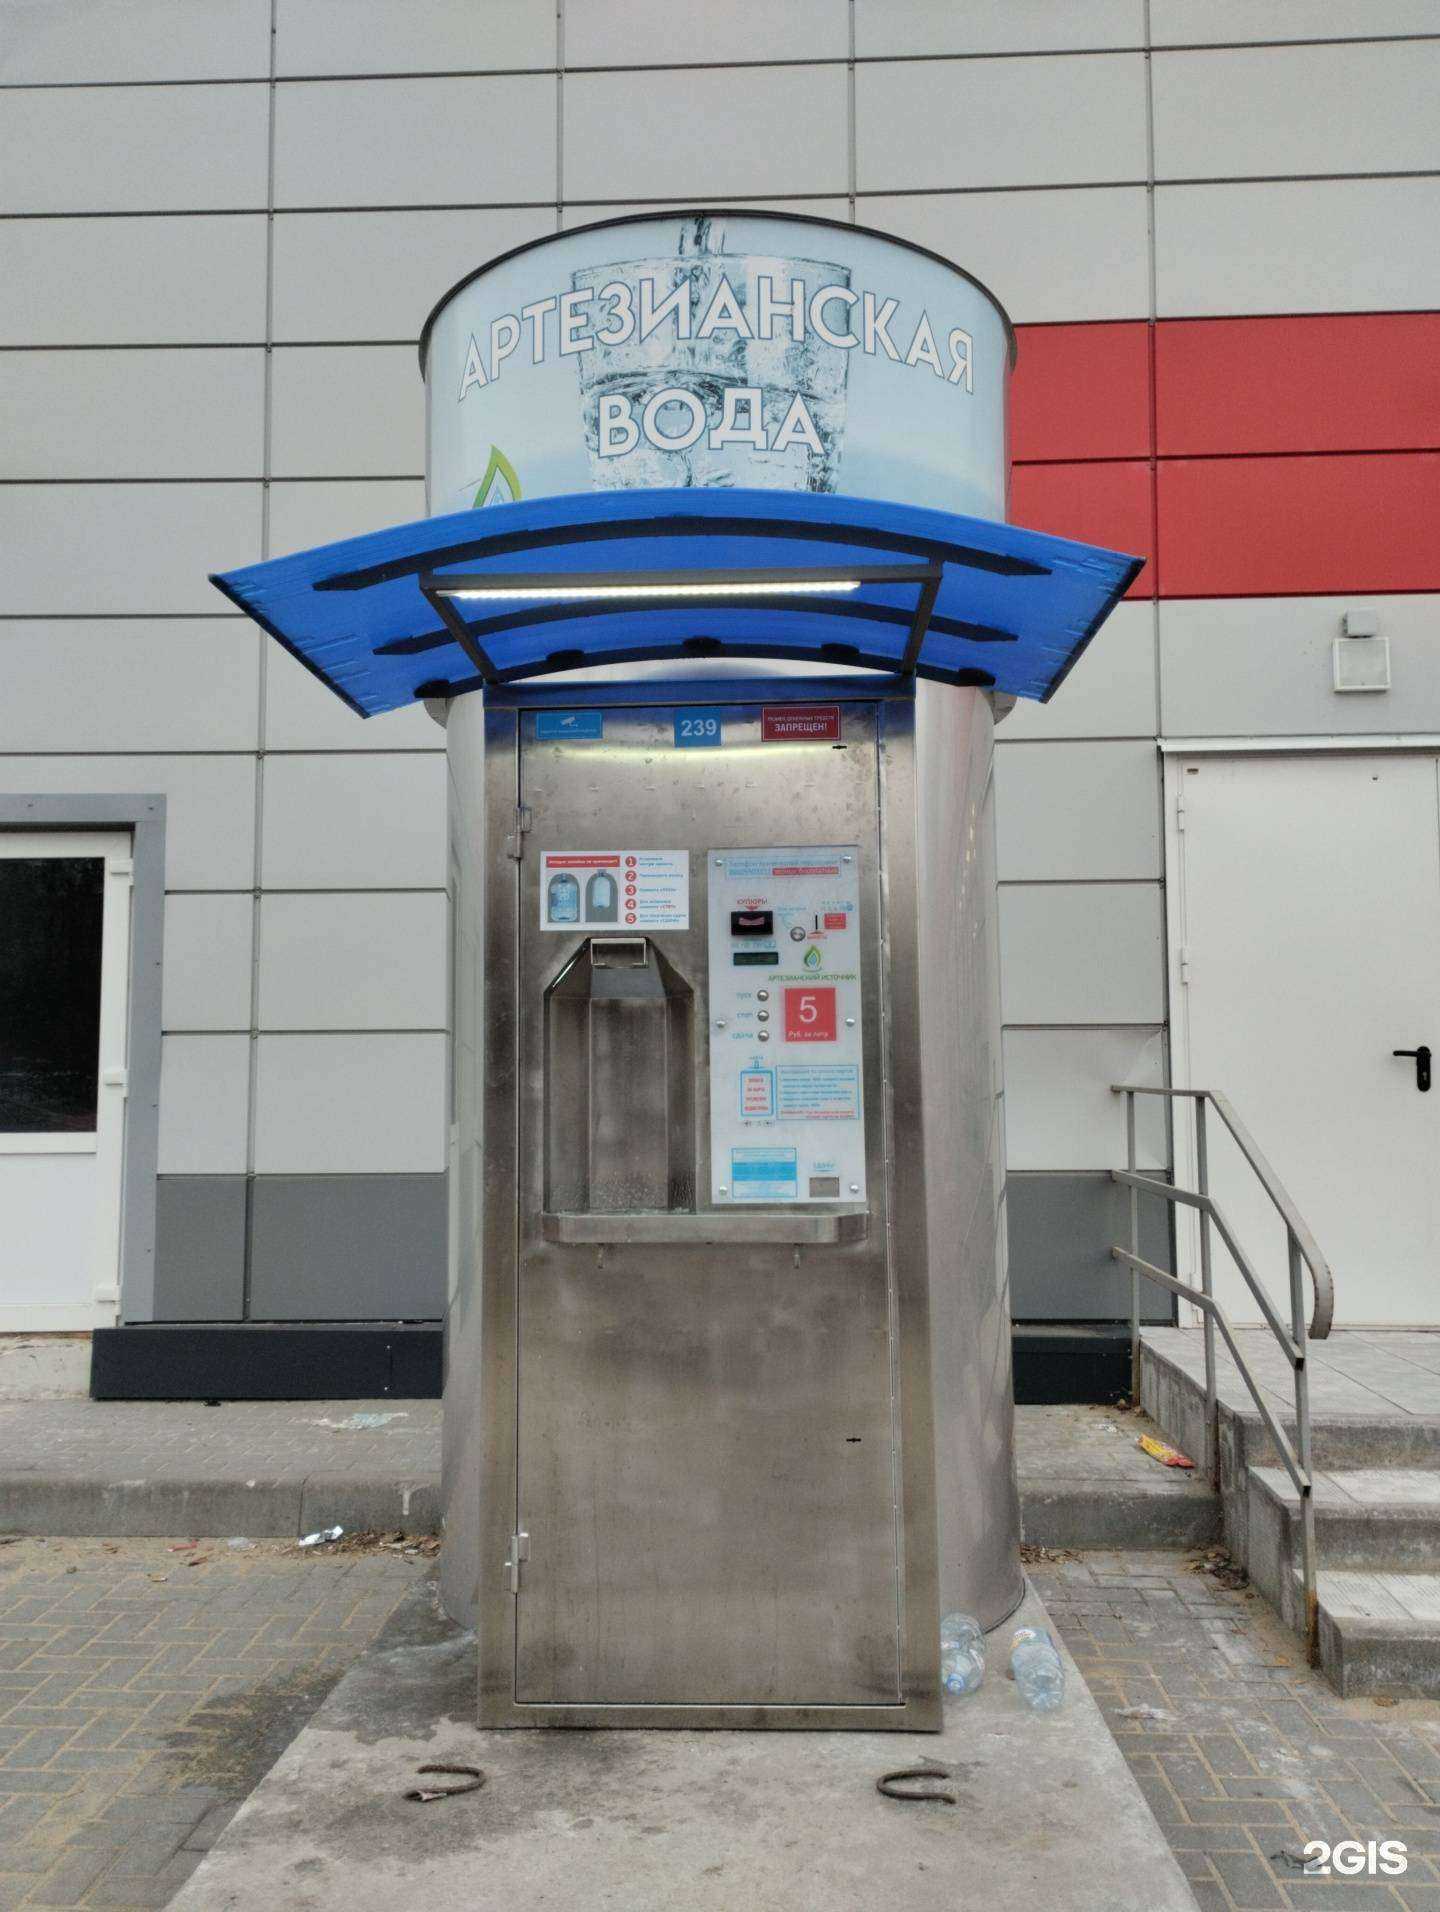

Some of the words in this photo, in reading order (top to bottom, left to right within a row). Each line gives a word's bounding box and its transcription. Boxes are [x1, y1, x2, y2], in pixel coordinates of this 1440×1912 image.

[457, 274, 975, 404] АРТЕЗИАНСКАЯ
[598, 387, 826, 460] ВОДА
[681, 719, 717, 736] 239
[774, 722, 828, 733] ЗАПРЕЩЕН!
[799, 996, 818, 1023] 5
